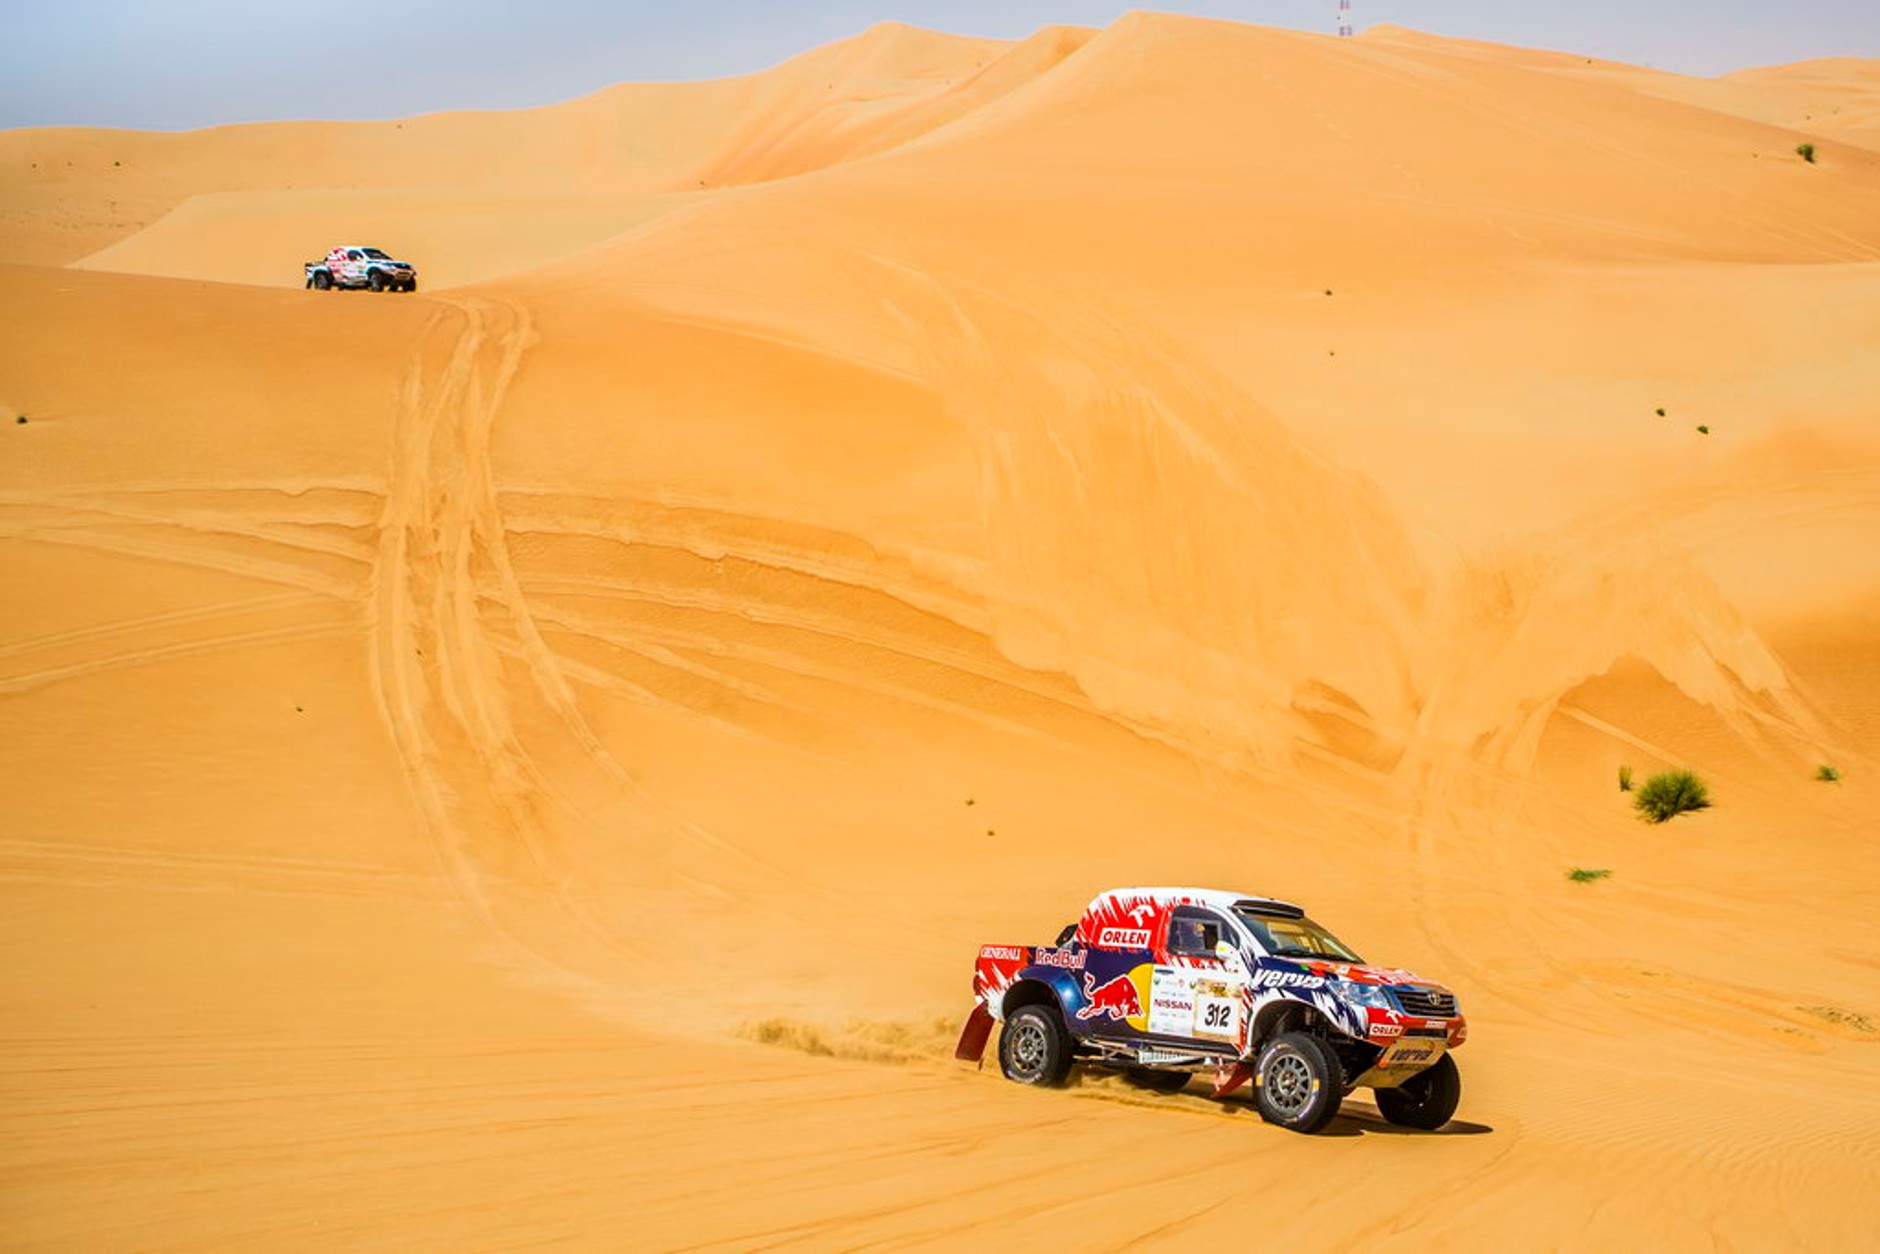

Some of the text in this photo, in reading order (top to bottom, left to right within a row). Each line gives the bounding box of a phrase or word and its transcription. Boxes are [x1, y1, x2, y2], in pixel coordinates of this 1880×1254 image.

[1102, 930, 1148, 945] ORLEN
[981, 947, 1021, 960] GENERALI
[1035, 947, 1088, 969] Red Bull
[1154, 998, 1192, 1011] NISSAN
[1204, 1003, 1231, 1028] 312
[1371, 1025, 1400, 1036] ORLEN
